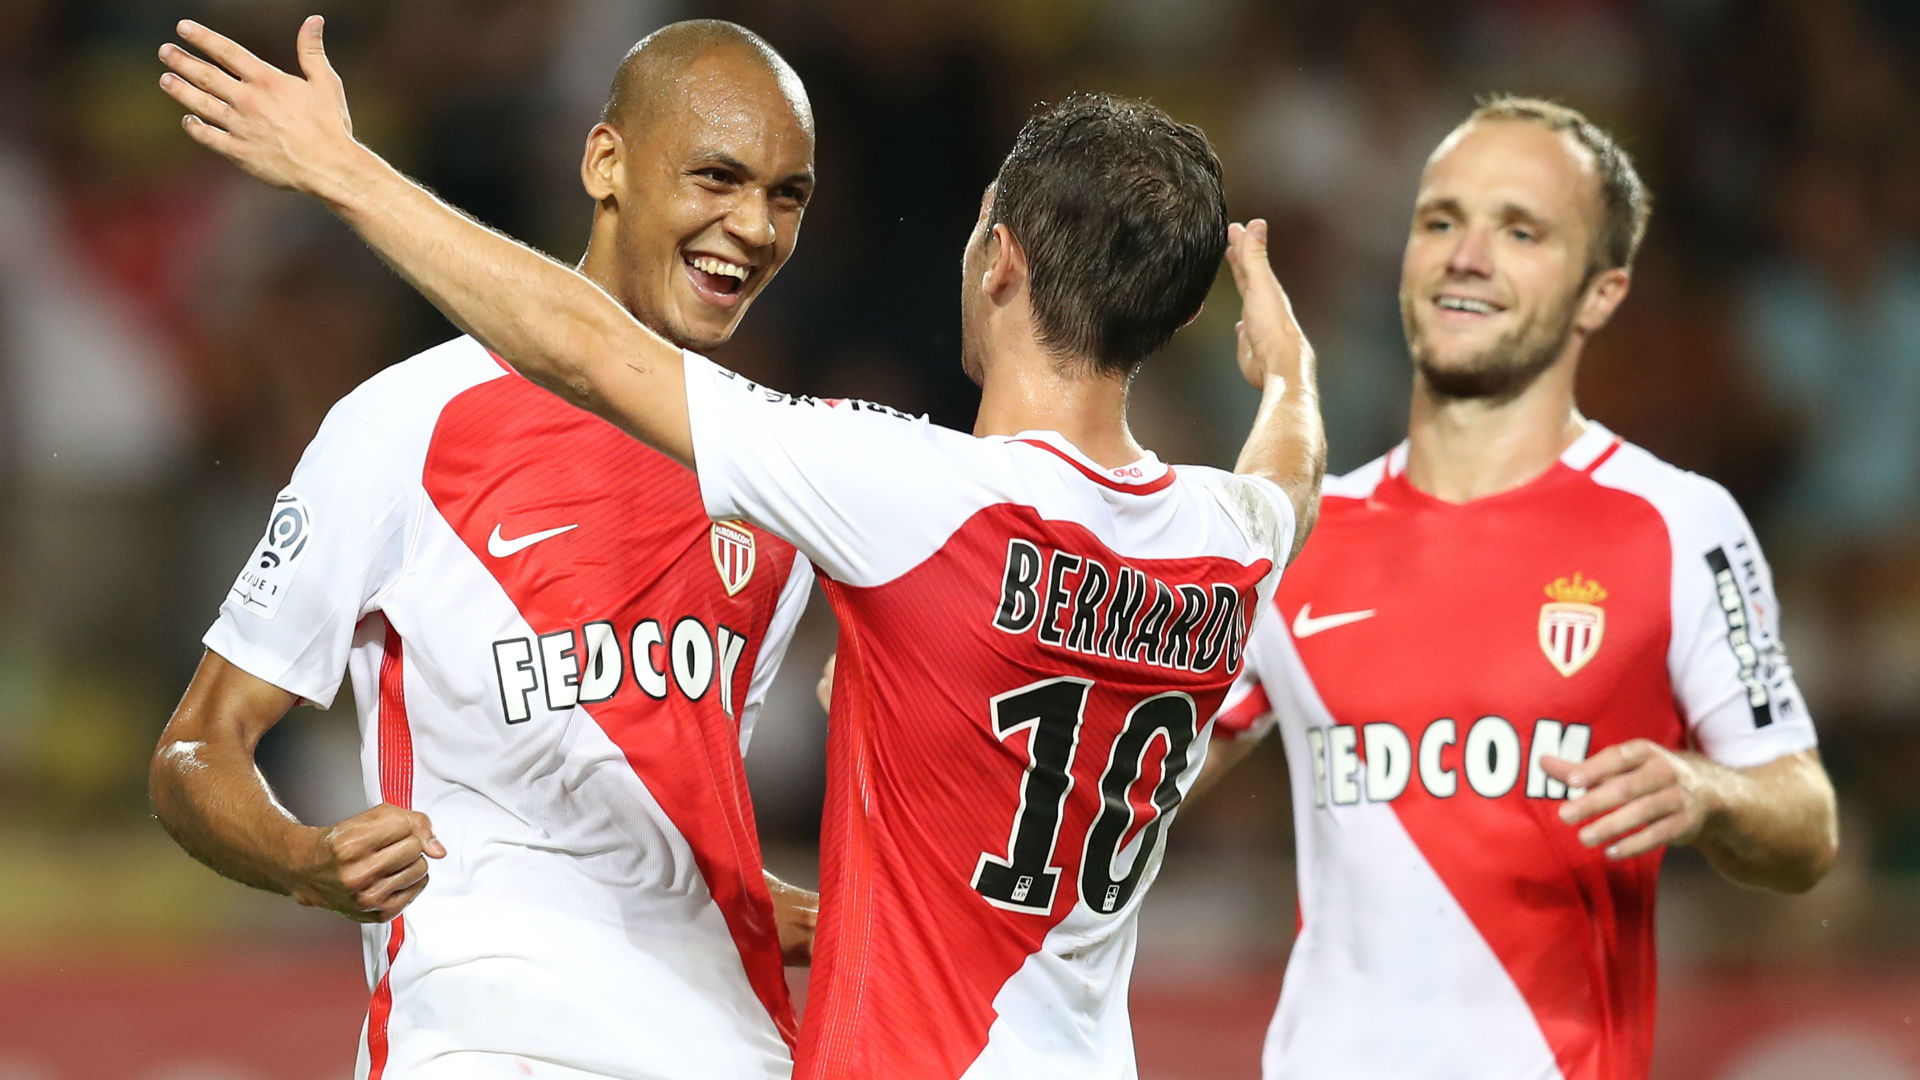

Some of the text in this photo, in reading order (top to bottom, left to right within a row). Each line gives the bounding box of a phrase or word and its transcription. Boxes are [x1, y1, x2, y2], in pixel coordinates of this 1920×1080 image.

[242, 571, 278, 596] LIUE 1
[970, 675, 1198, 920] 10
[1307, 715, 1592, 809] FEDCOM
